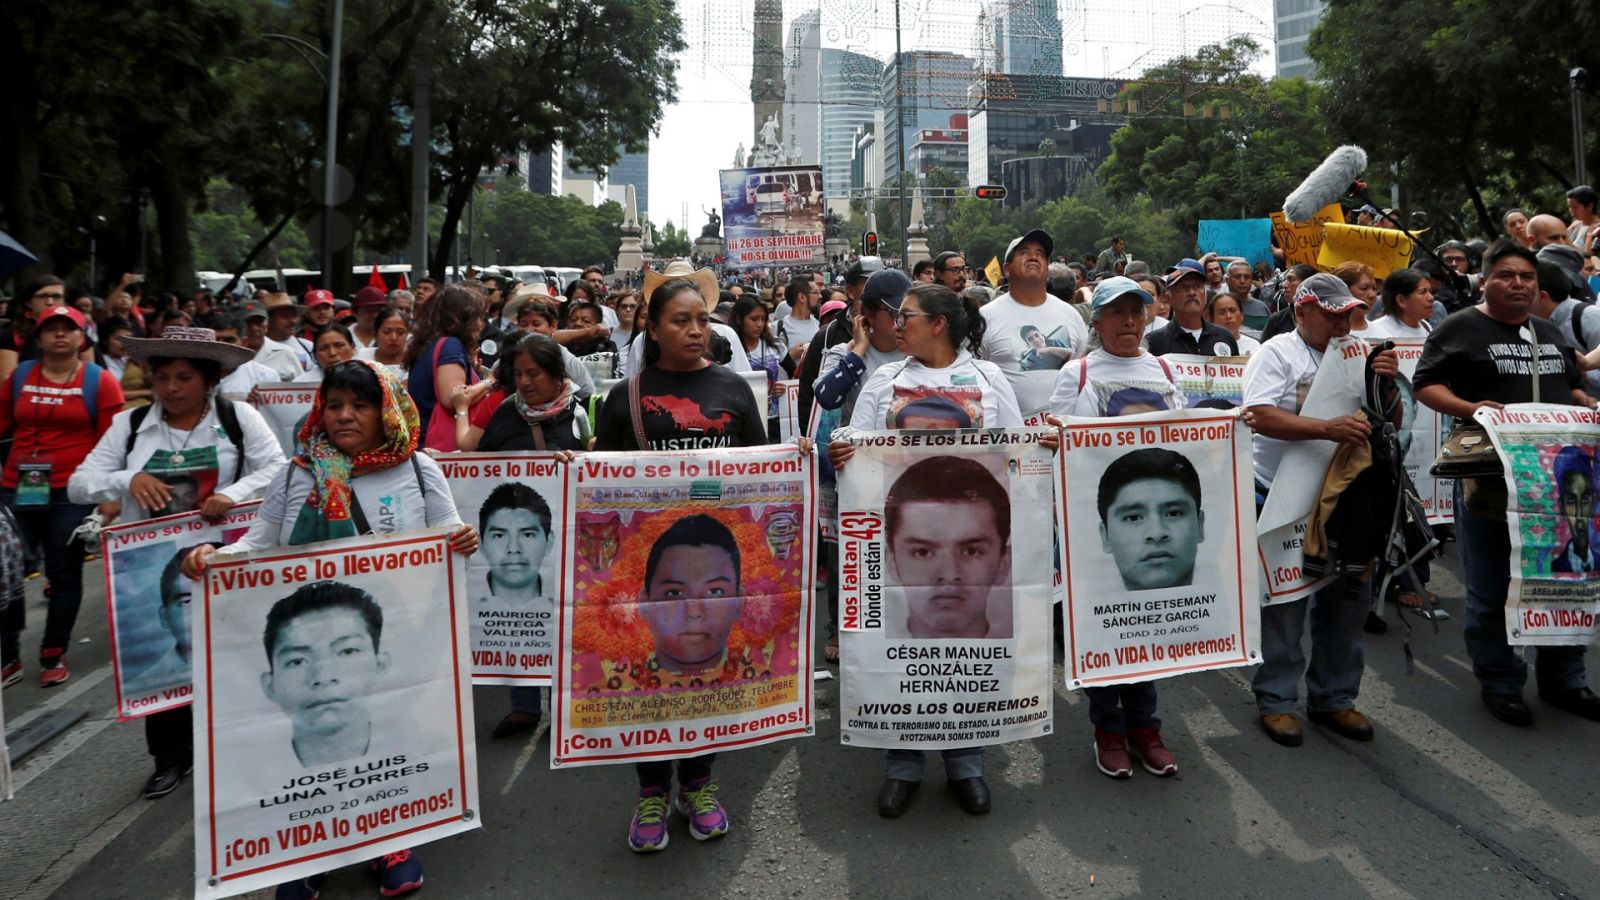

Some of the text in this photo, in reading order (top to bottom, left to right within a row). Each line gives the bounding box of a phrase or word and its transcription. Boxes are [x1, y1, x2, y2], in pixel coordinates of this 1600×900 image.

[1061, 80, 1116, 98] HSBC
[740, 239, 751, 248] 26
[754, 238, 765, 247] DE
[768, 235, 821, 246] SEPTIEMBRE
[741, 252, 753, 261] NO
[756, 250, 766, 260] SE
[769, 250, 800, 260] OLVIDA
[1187, 366, 1201, 375] se
[1204, 365, 1216, 377] lo
[297, 394, 311, 403] se
[1024, 417, 1038, 427] se
[1532, 413, 1551, 423] se
[1550, 411, 1569, 423] lo
[901, 435, 921, 446] SE
[926, 434, 956, 446] LOS
[1066, 423, 1231, 450] ¡Vivo se lo llevaron!
[484, 465, 502, 477] se
[506, 462, 521, 476] lo
[577, 457, 803, 482] ¡Vivo se lo llevaron!
[114, 531, 157, 549] ¡Vivo
[163, 524, 182, 537] se
[188, 520, 203, 532] lo
[213, 543, 443, 595] ¡Vivo se lo llevaron!
[1274, 566, 1302, 586] ¡Con
[843, 541, 858, 628] Nos faltan
[864, 542, 881, 628] Dónde están
[1094, 594, 1216, 615] MARTÍN GETSEMANY
[478, 611, 551, 619] MAURICIO
[484, 620, 544, 628] ORTEGA
[1103, 608, 1210, 629] SÁNCHEZ GARCÍA
[1524, 609, 1593, 630] ¡Con VIDA lo
[483, 629, 546, 637] VALERIO
[1120, 631, 1150, 639] EDAD
[1170, 625, 1199, 634] AÑOS
[524, 640, 551, 648] AÑOS
[886, 644, 1012, 660] CÉSAR MANUEL
[472, 650, 502, 666] VIDA
[506, 650, 516, 667] lo
[1081, 634, 1236, 673] ¡Con VIDA lo queremos!
[906, 661, 993, 676] GONZÁLEZ
[900, 678, 999, 693] HERNÁNDEZ
[575, 701, 634, 713] CHRISTIAN
[641, 697, 686, 708] ALFONSO
[752, 680, 794, 696] TELUMBRE
[858, 696, 1039, 716] ¡VIVOS LOS QUEREMOS
[582, 717, 602, 725] Hijo
[607, 712, 617, 721] de
[621, 711, 660, 721] Clemente
[665, 711, 670, 719] y
[675, 707, 688, 716] Luz
[848, 711, 1047, 730] CONTRA EL TERRORISMO DEL ESTADO, LA SOLIDARIDAD
[563, 707, 803, 754] ¡Con VIDA lo queremos!
[900, 730, 1000, 741] AYOTZINAPA SOMXS TODXS
[283, 754, 407, 790] JOSÉ LUIS
[259, 762, 430, 808] LUNA TORRES
[289, 785, 409, 821] EDAD 20 AÑOS
[225, 788, 454, 867] ¡Con VIDA lo queremos!
